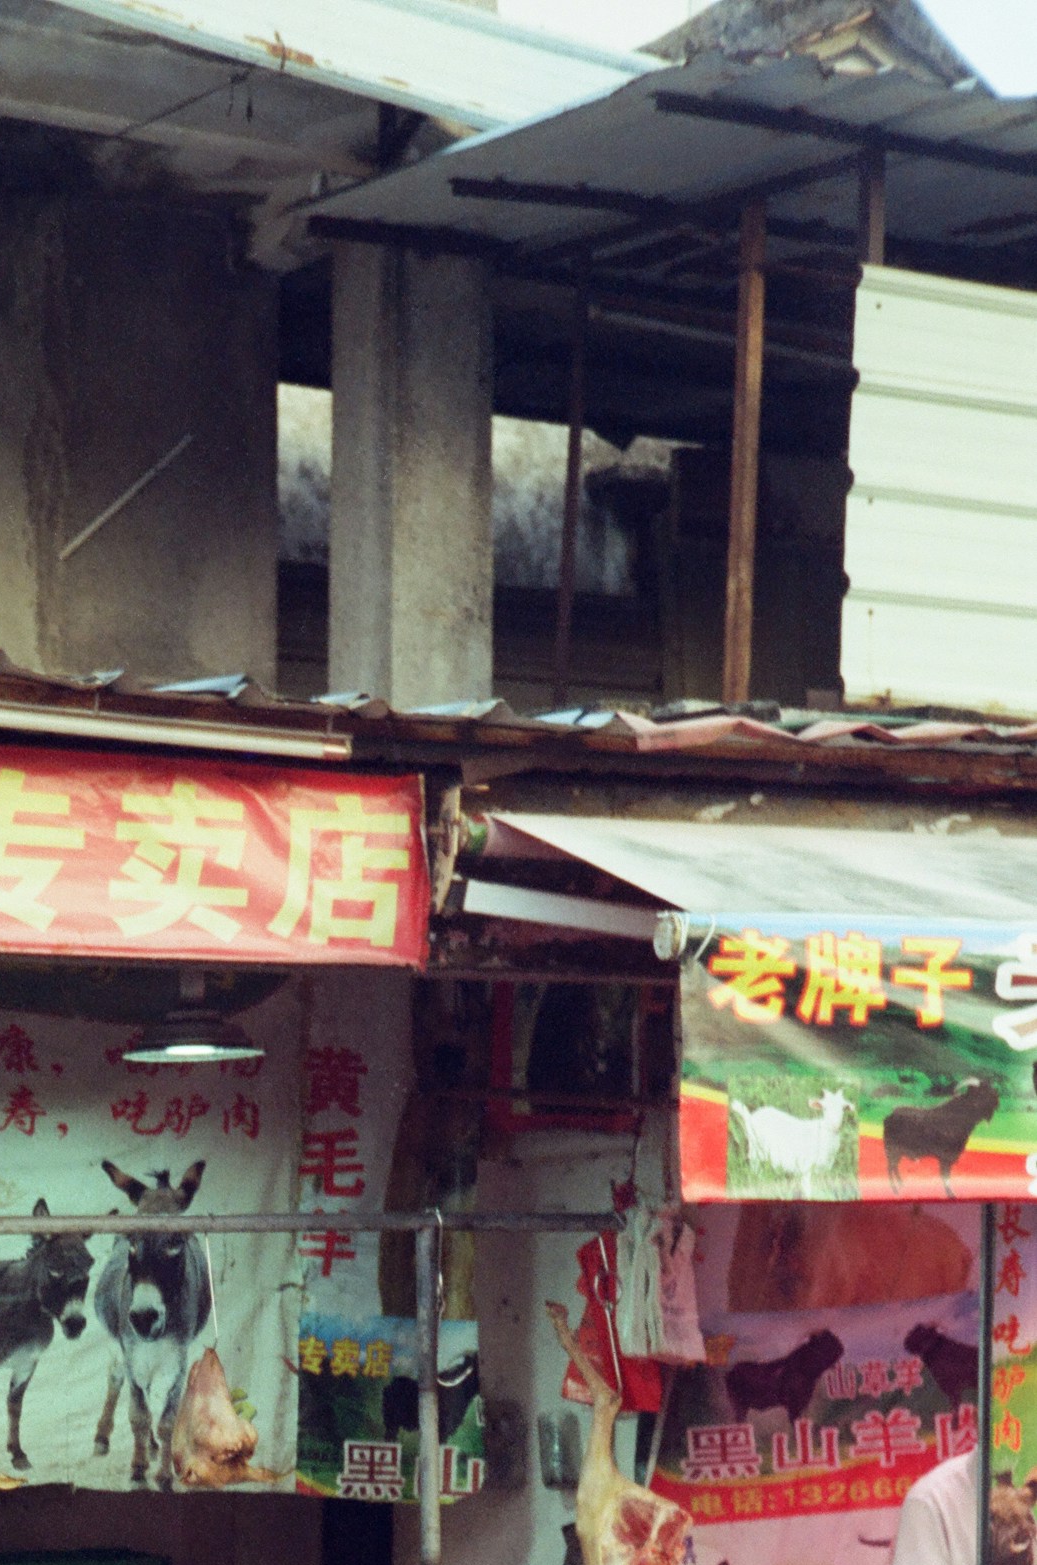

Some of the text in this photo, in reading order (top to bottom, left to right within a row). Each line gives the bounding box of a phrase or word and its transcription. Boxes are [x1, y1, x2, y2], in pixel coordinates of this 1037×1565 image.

[708, 927, 974, 1030] 老牌子
[111, 1091, 260, 1140] 吃驴肉
[299, 1332, 393, 1378] 专卖店
